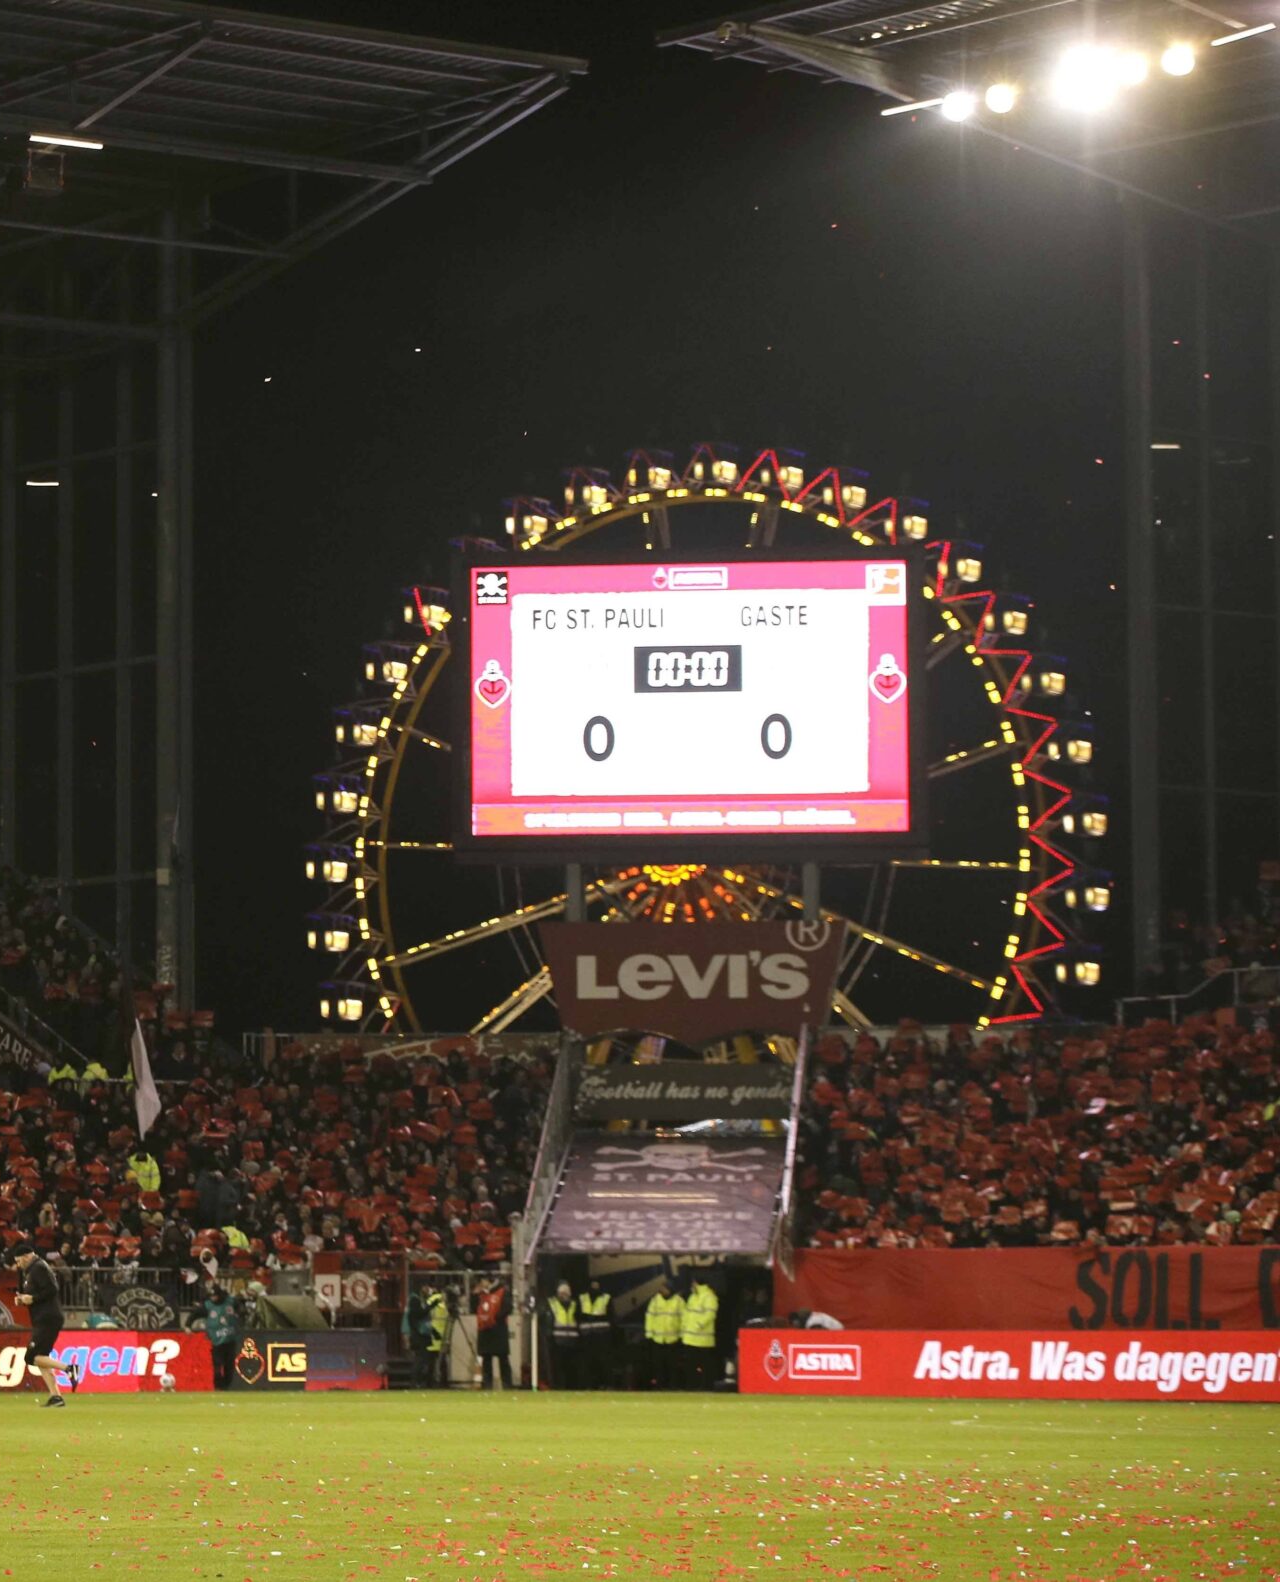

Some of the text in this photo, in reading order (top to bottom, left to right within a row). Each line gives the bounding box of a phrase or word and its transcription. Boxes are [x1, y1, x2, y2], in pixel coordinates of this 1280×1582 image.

[532, 609, 557, 631] FC
[567, 608, 596, 630] ST.
[604, 607, 664, 629] PAULI
[647, 651, 730, 688] 00:00
[582, 715, 615, 762] 0
[760, 713, 792, 760] 0
[665, 1082, 701, 1100] has
[704, 1085, 729, 1099] no
[646, 1173, 755, 1183] PAULI
[572, 1209, 754, 1221] WELCOME
[794, 1352, 856, 1372] ASTRA
[914, 1340, 1020, 1382] Astra.
[1030, 1341, 1106, 1382] Was
